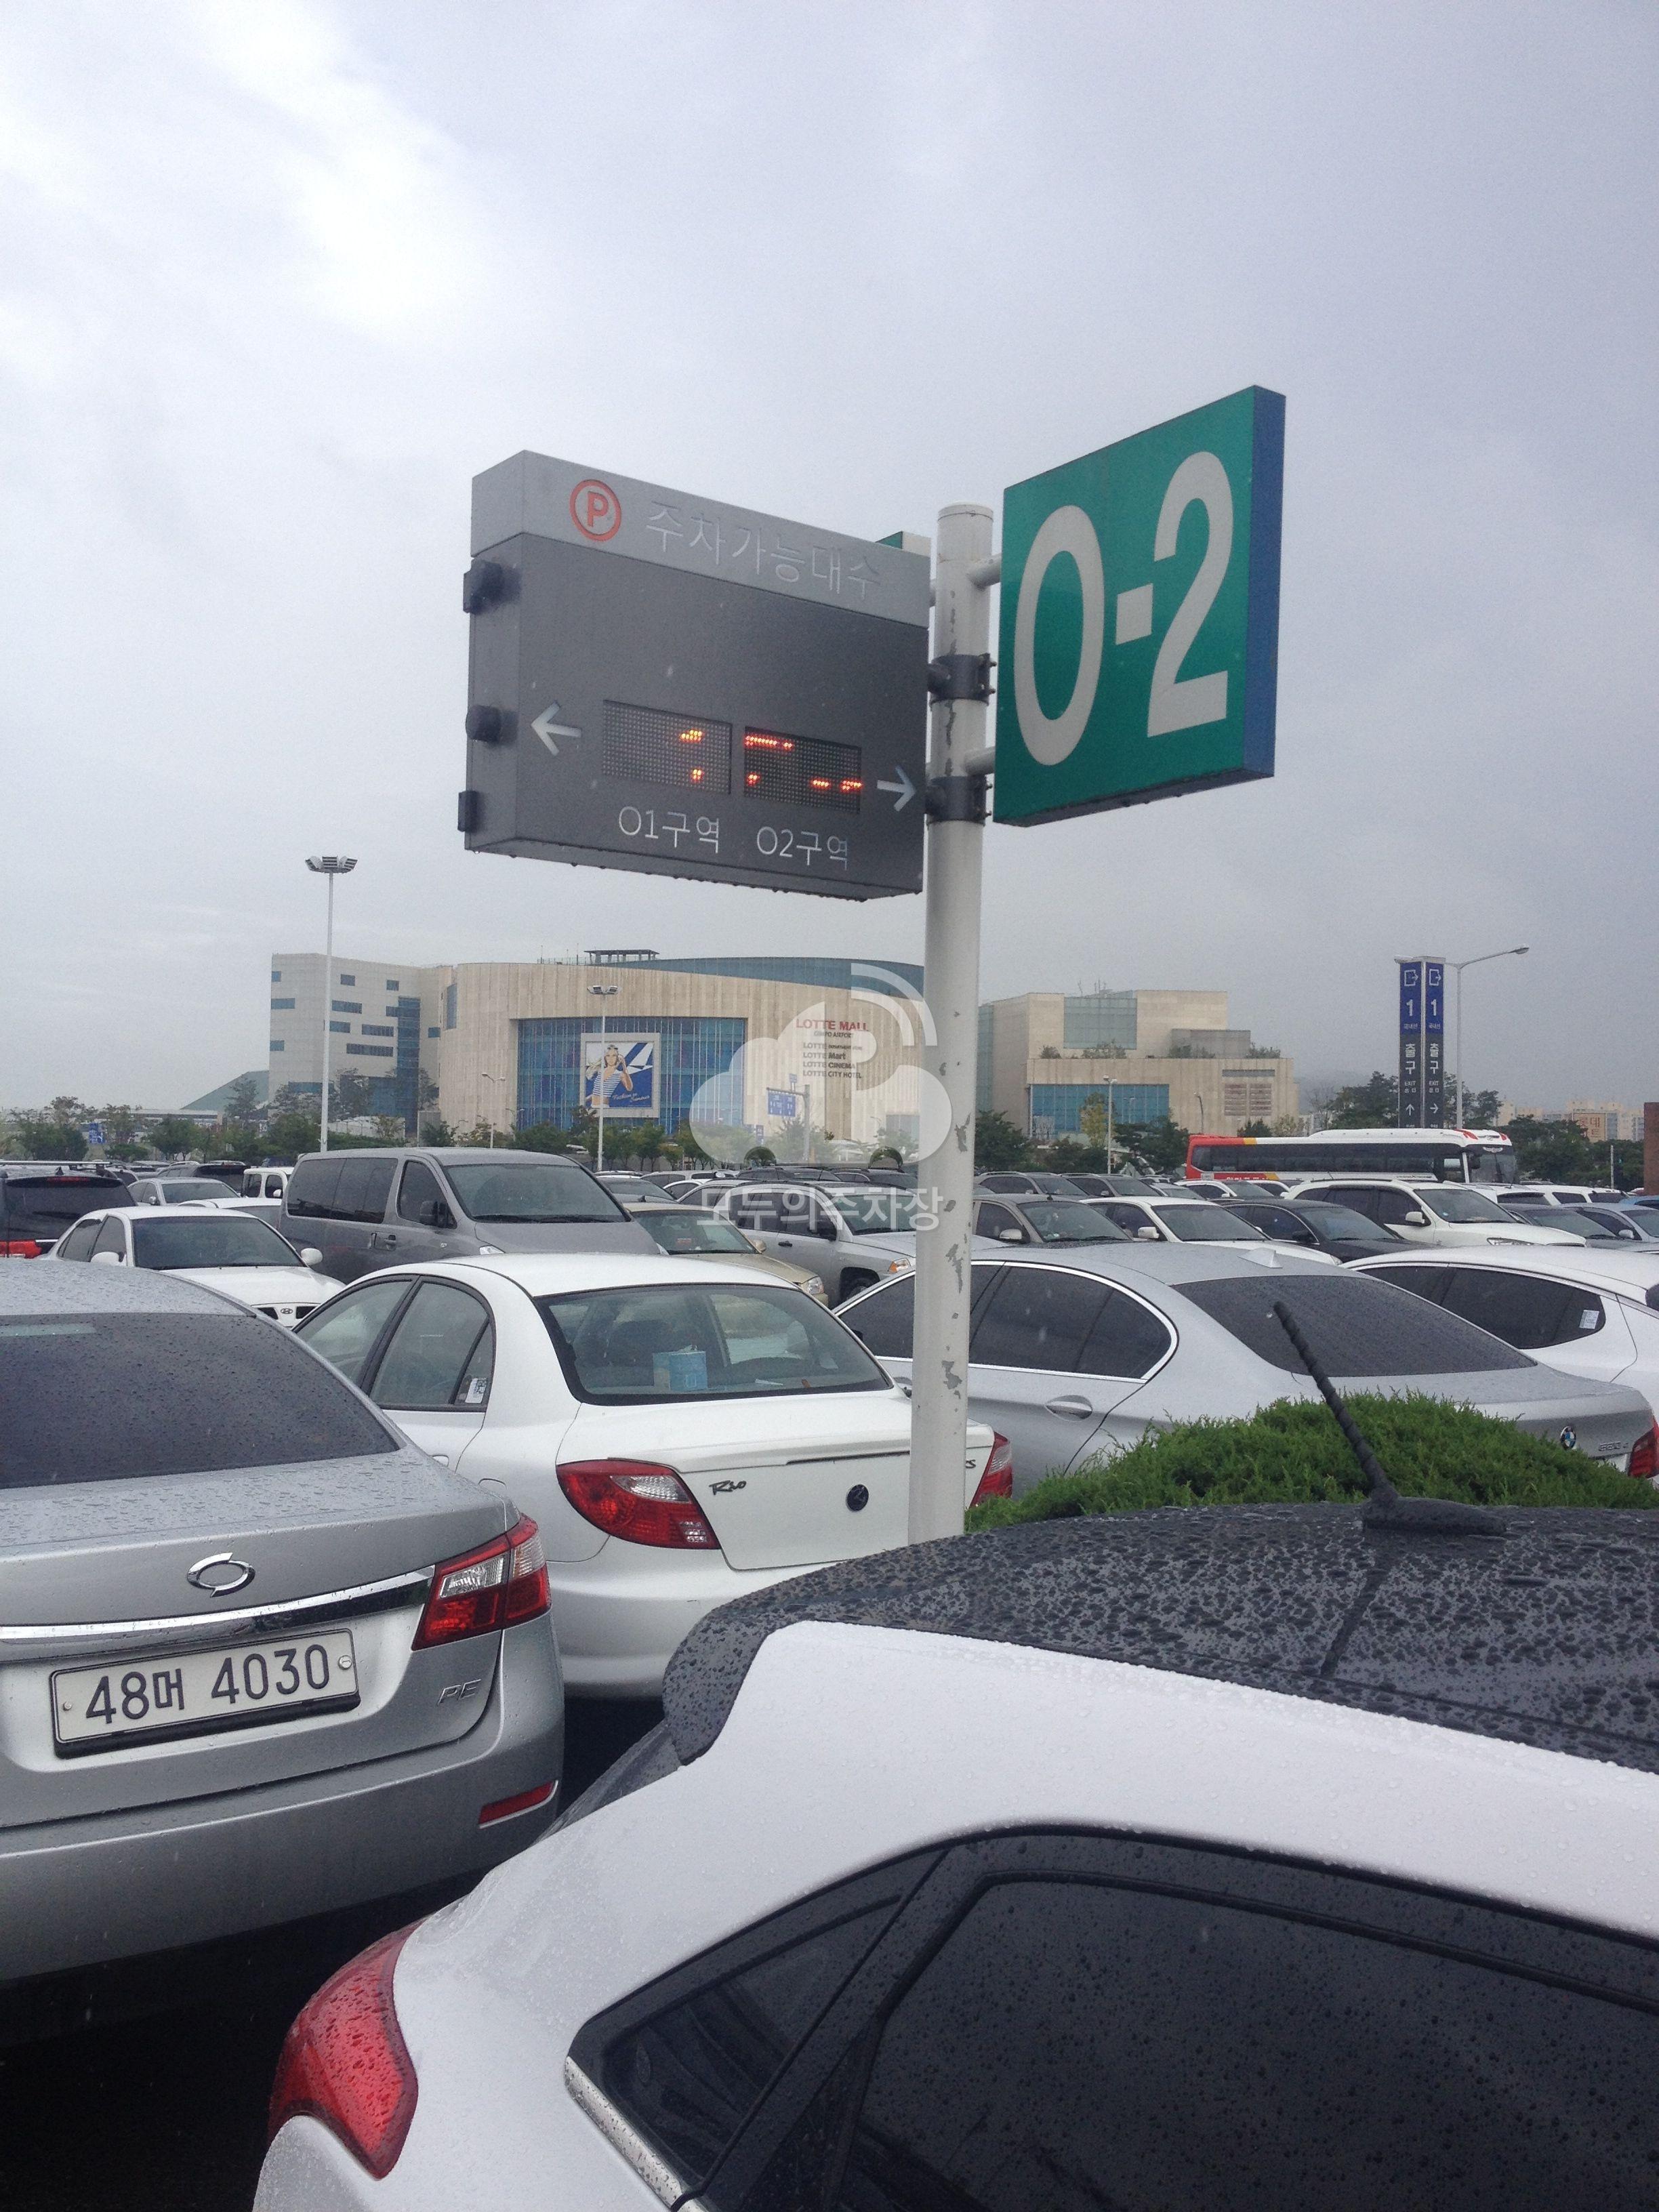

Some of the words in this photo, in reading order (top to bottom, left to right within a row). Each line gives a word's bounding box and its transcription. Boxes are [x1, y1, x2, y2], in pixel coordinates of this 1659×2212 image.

[645, 500, 882, 602] 주차가능대수
[1406, 999, 1413, 1017] 1
[1431, 999, 1437, 1016] 1
[796, 1019, 836, 1030] LOTTE
[839, 1021, 871, 1031] MALL
[1405, 1044, 1416, 1075] 출구
[1429, 1042, 1439, 1074] 출구
[709, 1480, 747, 1496] Rio
[85, 1668, 184, 1724] 48머
[211, 1644, 331, 1704] 4030
[437, 1679, 482, 1706] PE
